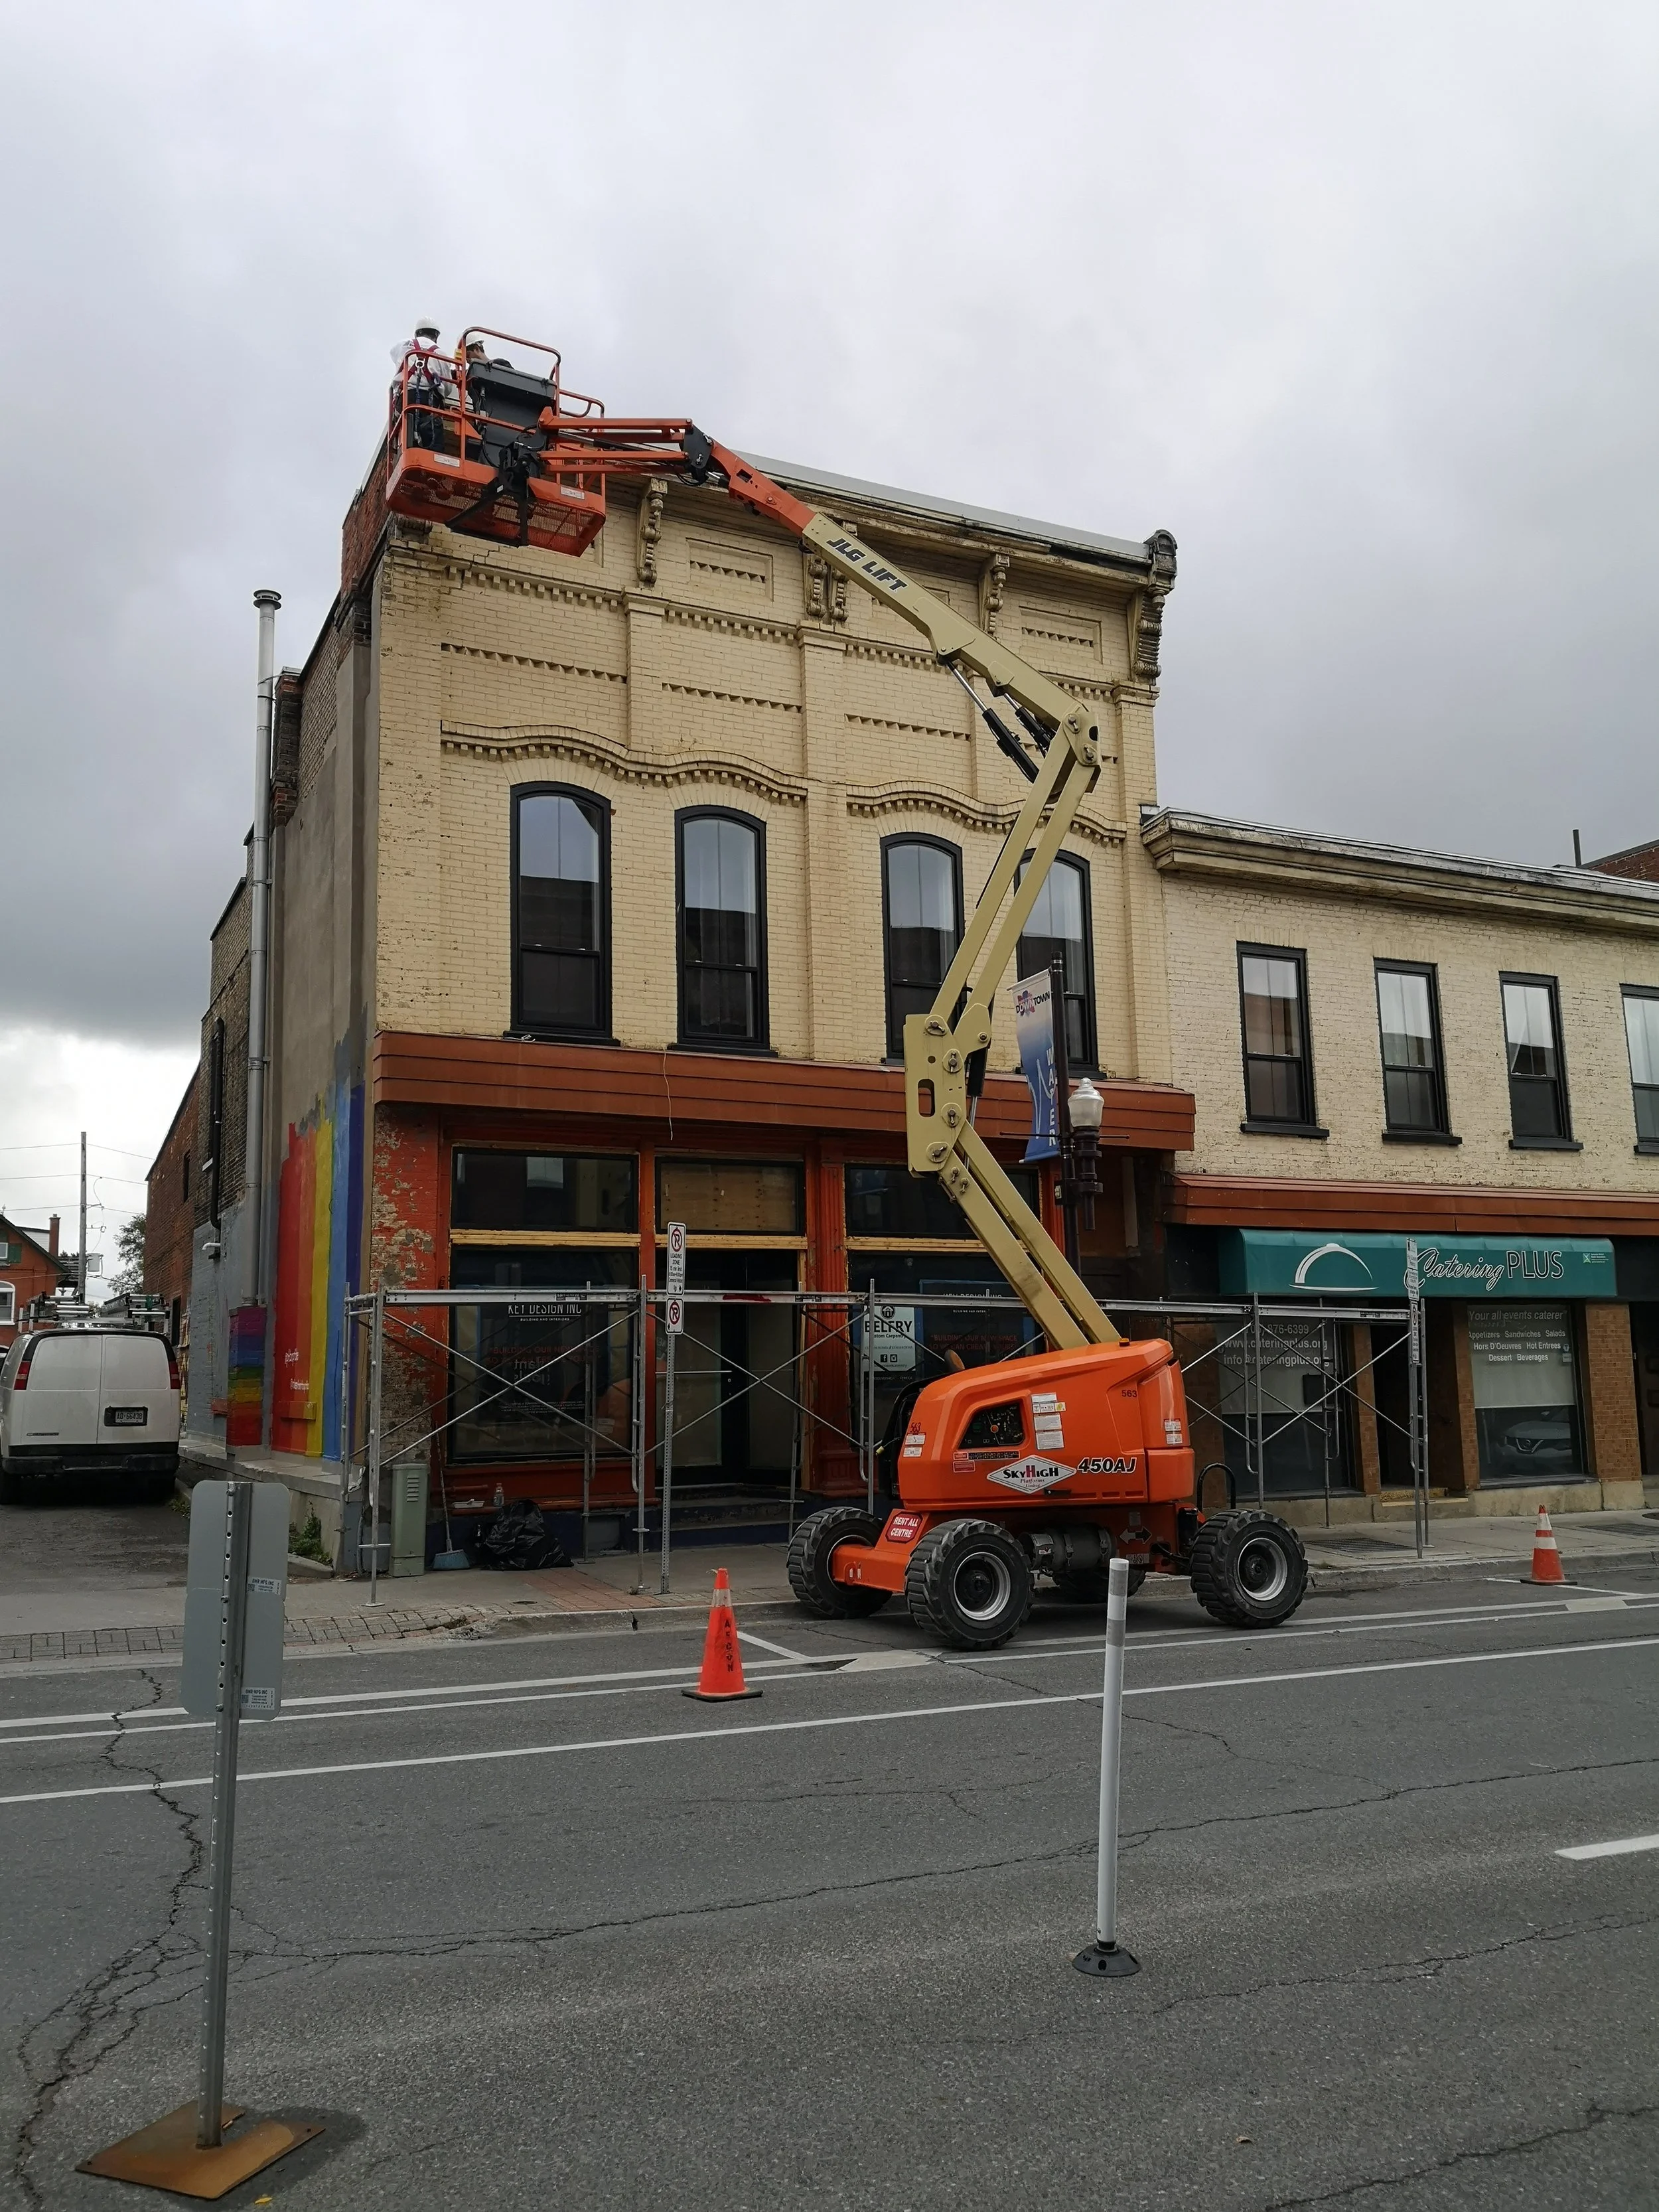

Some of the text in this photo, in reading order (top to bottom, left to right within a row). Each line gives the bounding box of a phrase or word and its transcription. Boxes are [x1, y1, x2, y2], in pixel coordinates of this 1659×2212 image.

[826, 538, 908, 591] JLG LIFT
[1016, 991, 1050, 1014] DOWNTOWN
[1404, 1248, 1504, 1291] Catering
[1506, 1250, 1563, 1278] PLUS
[530, 1303, 563, 1314] DESIGN
[567, 1303, 582, 1314] INC
[1491, 1310, 1502, 1319] all
[1504, 1310, 1532, 1320] events
[865, 1321, 912, 1333] BELFRY
[1268, 1324, 1309, 1334] 876-6399
[1469, 1331, 1500, 1340] Appetizers
[1225, 1338, 1327, 1351] www.cteringplus.org
[1516, 1353, 1548, 1362] Beverages
[910, 1422, 921, 1433] 563
[1078, 1457, 1137, 1474] 450AJ
[893, 1516, 918, 1527] RENT ALL
[891, 1528, 913, 1538] CENTRE
